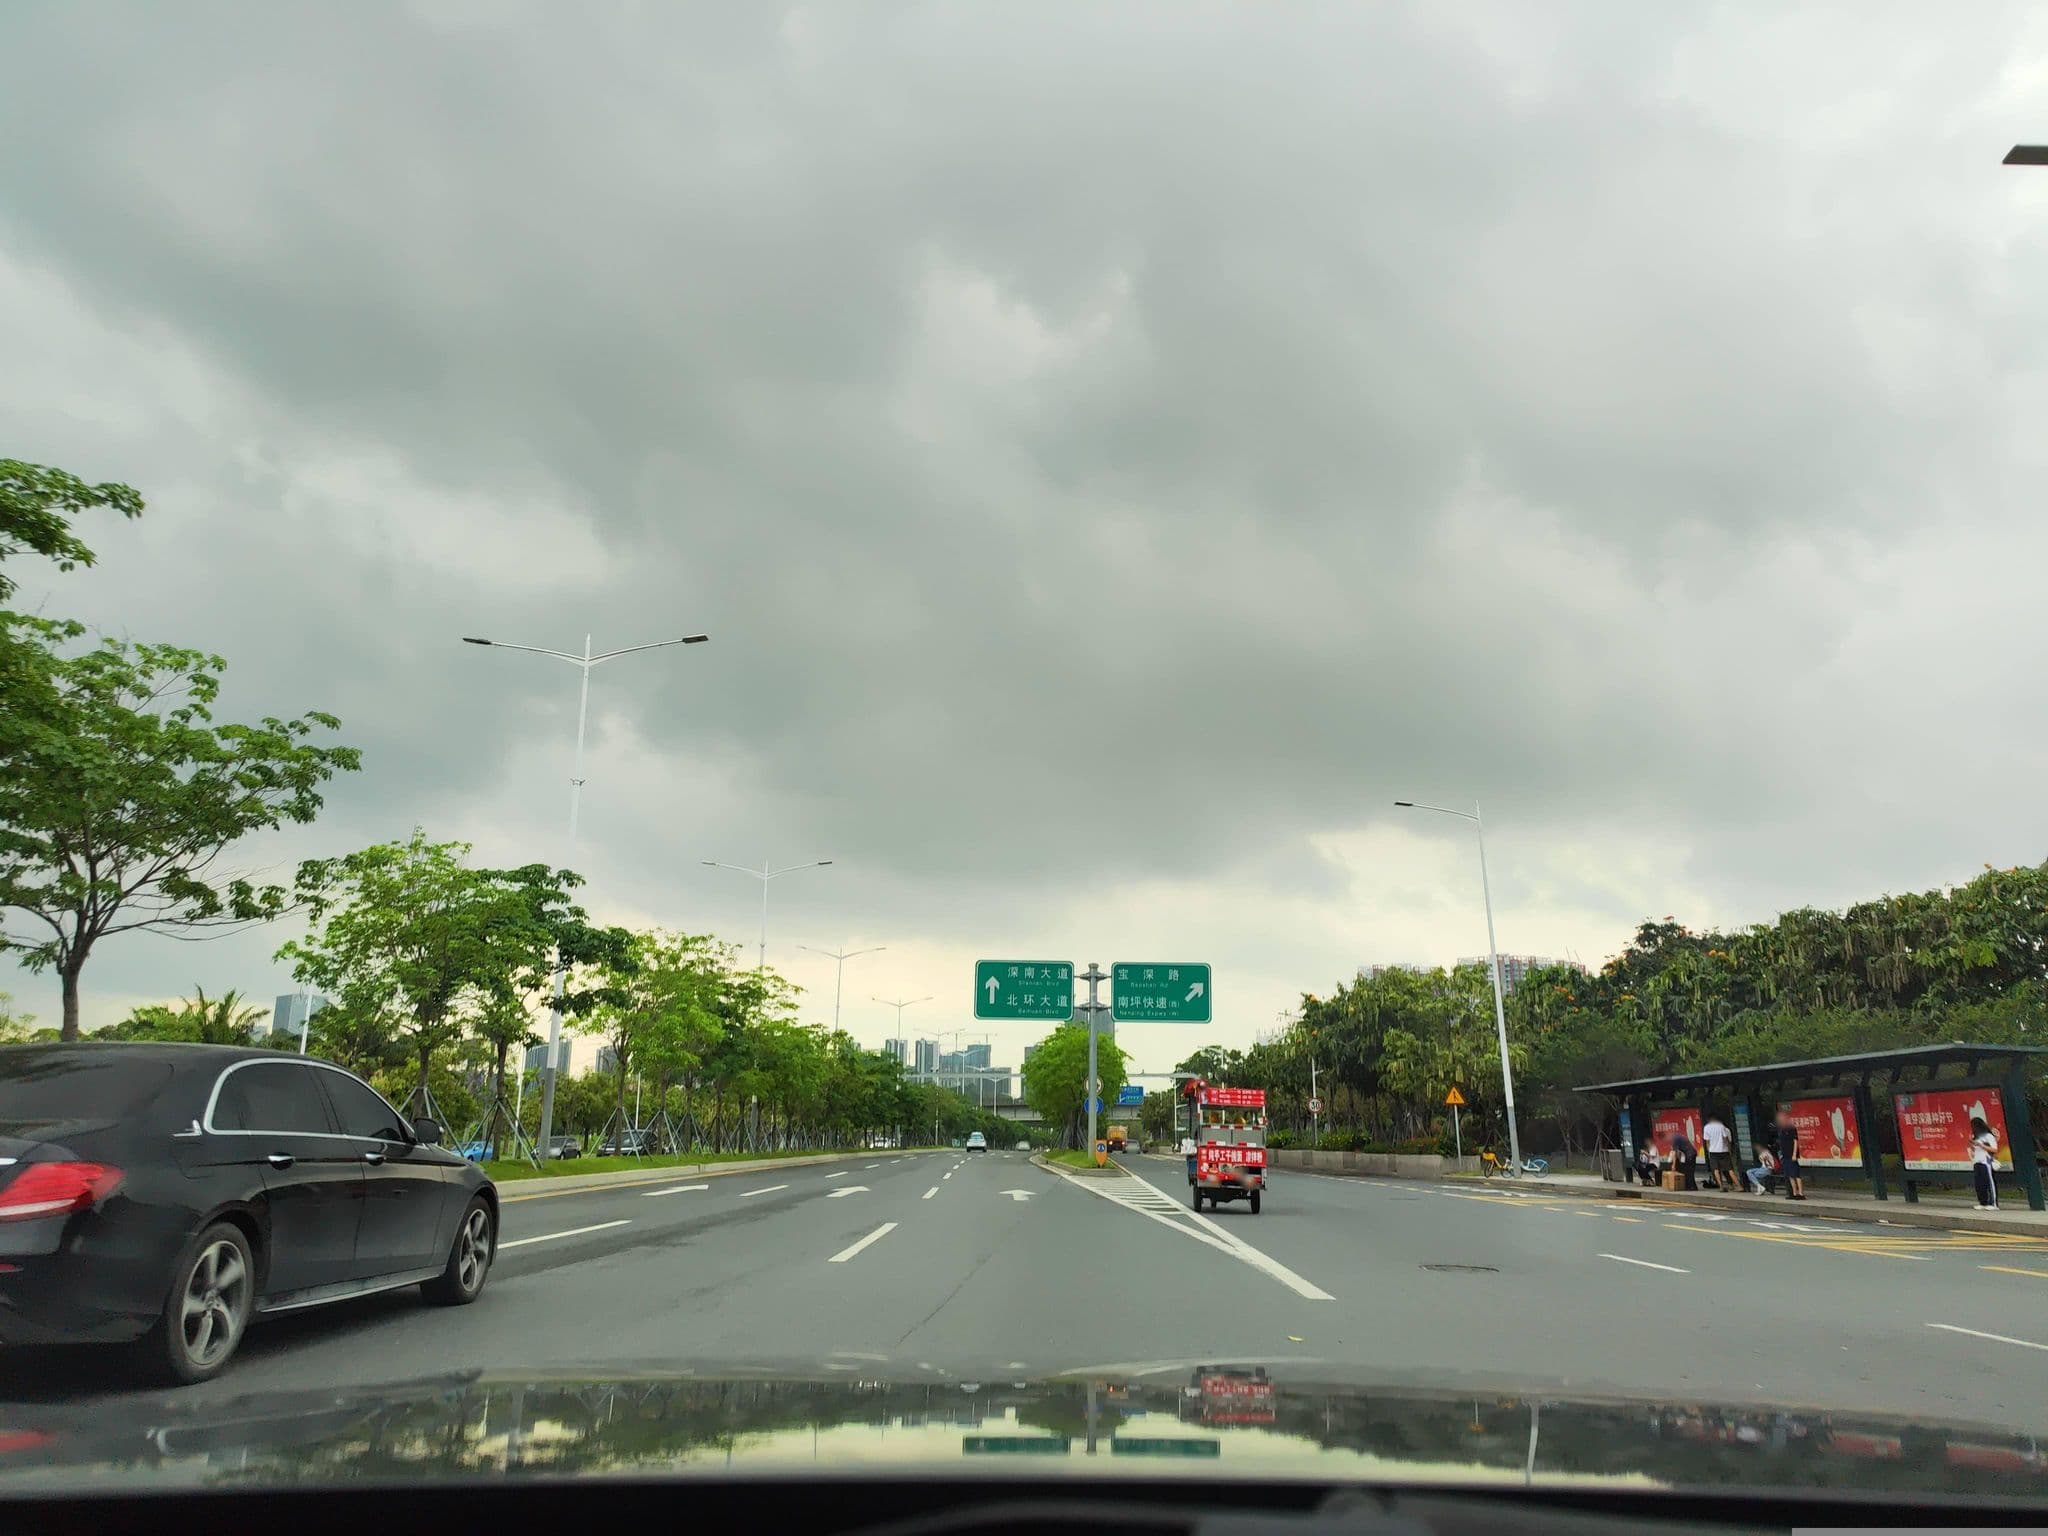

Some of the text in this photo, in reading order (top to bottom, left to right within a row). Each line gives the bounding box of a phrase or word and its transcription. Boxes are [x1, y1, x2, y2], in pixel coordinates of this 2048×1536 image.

[1007, 966, 1068, 980] 深南大道
[1118, 968, 1179, 981] 宝深路
[1007, 994, 1068, 1007] 北环大道
